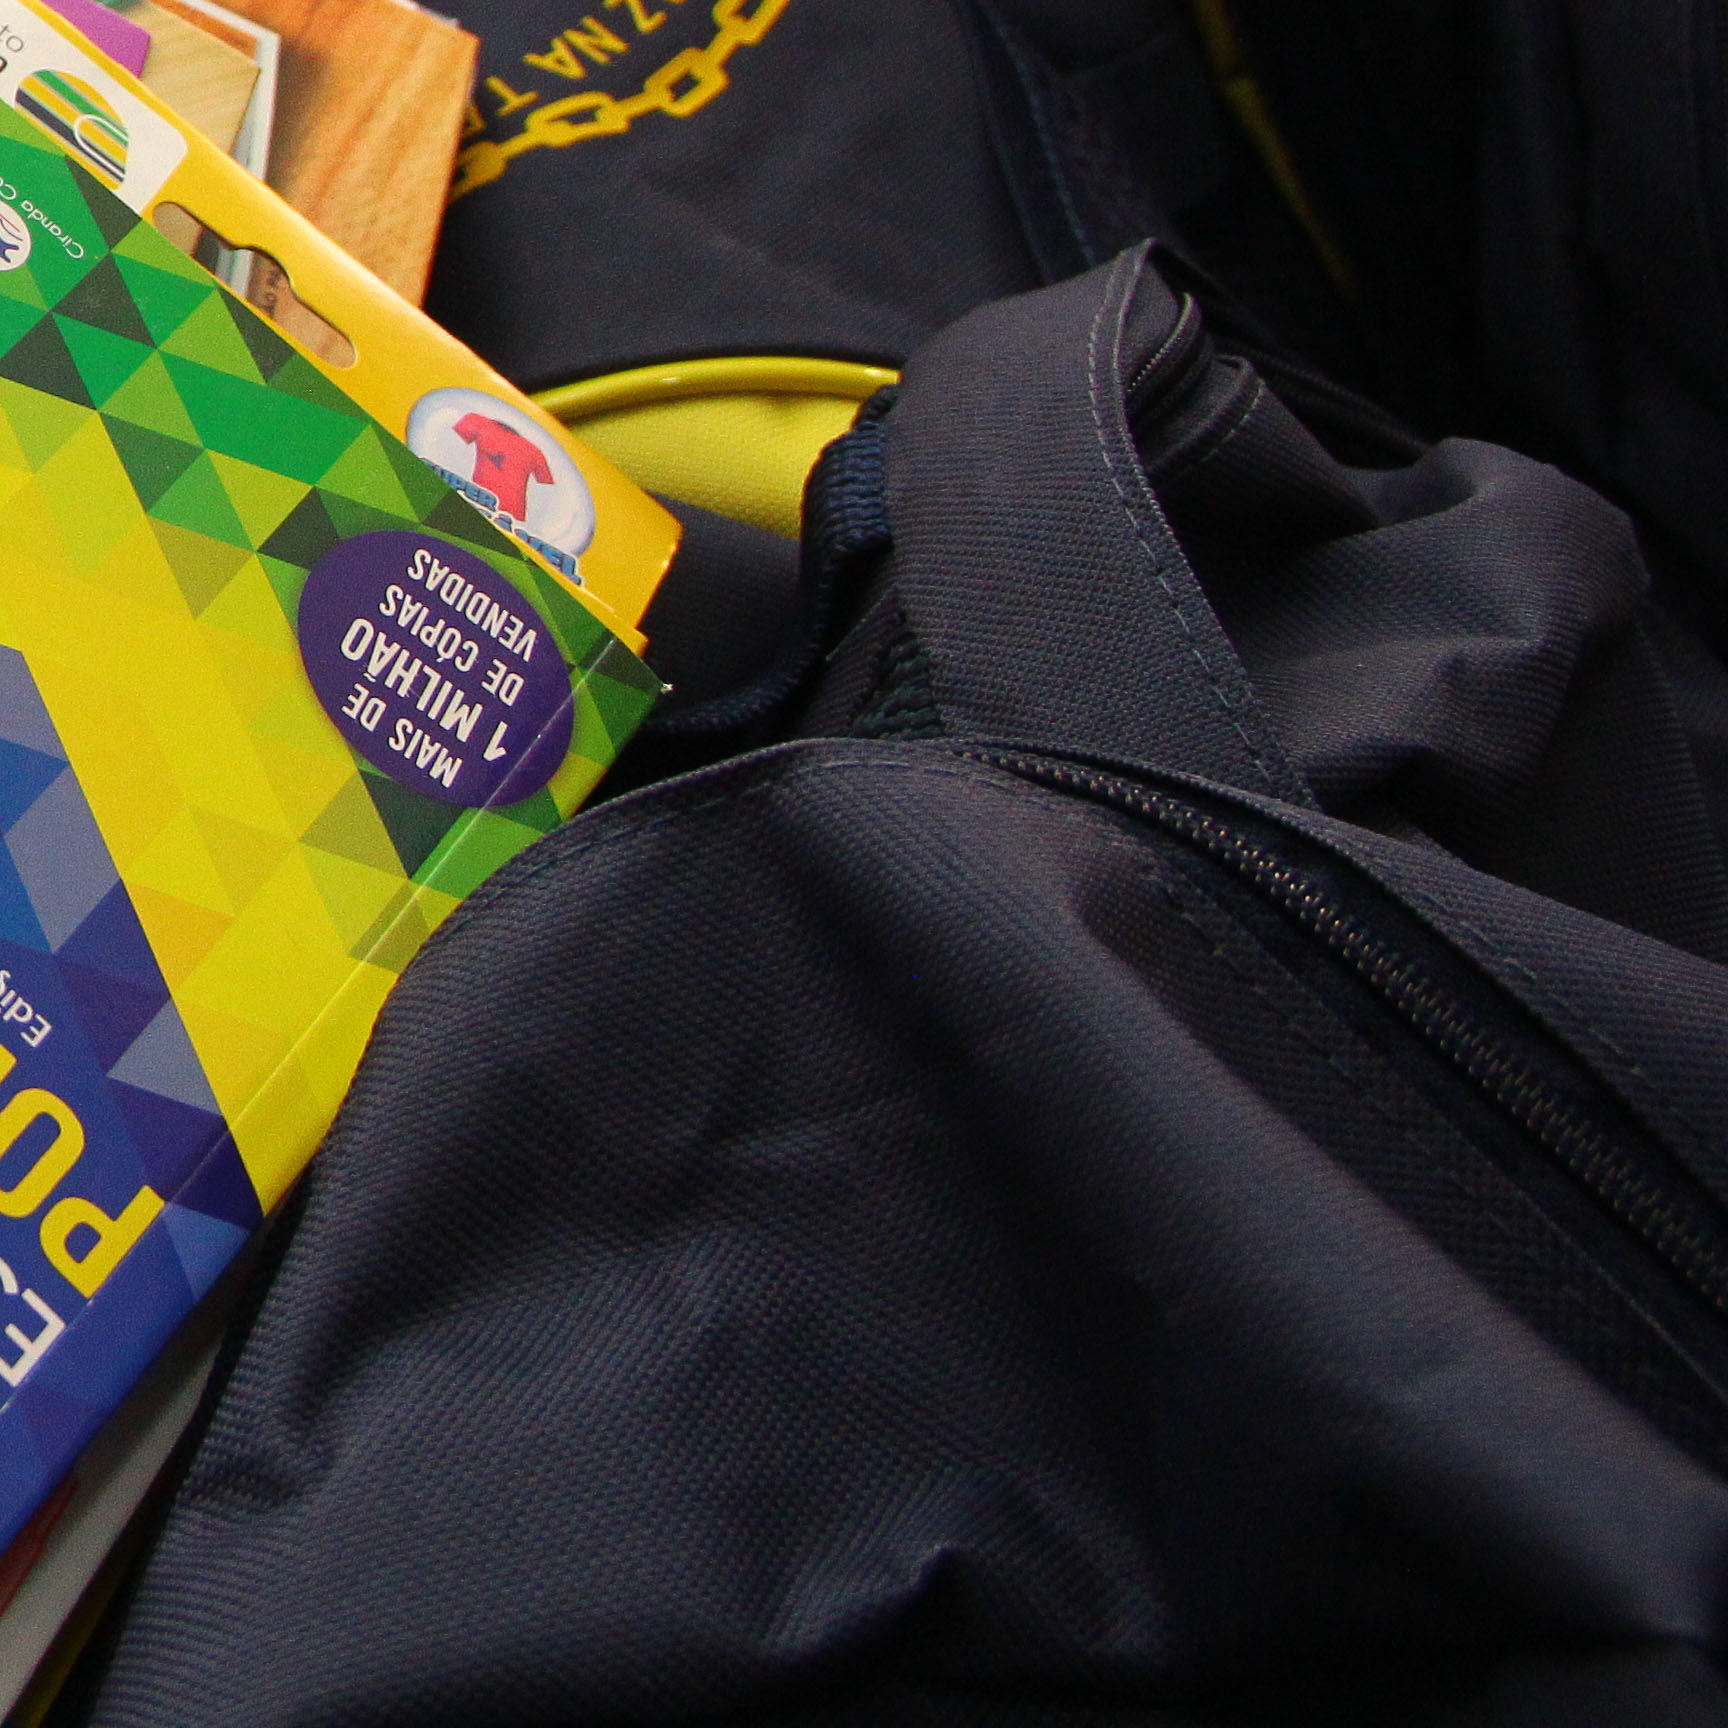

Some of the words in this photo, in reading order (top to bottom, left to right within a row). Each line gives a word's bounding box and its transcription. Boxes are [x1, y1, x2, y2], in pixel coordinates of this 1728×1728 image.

[524, 16, 630, 81] NA
[20, 199, 85, 259] Ciranda
[378, 583, 480, 673] CÓPIAS
[406, 548, 537, 663] VENDIDAS
[340, 617, 484, 744] MILHÃO
[341, 682, 387, 732] DE
[481, 667, 525, 707] DE
[389, 717, 463, 789] MAIS
[482, 720, 509, 762] 1
